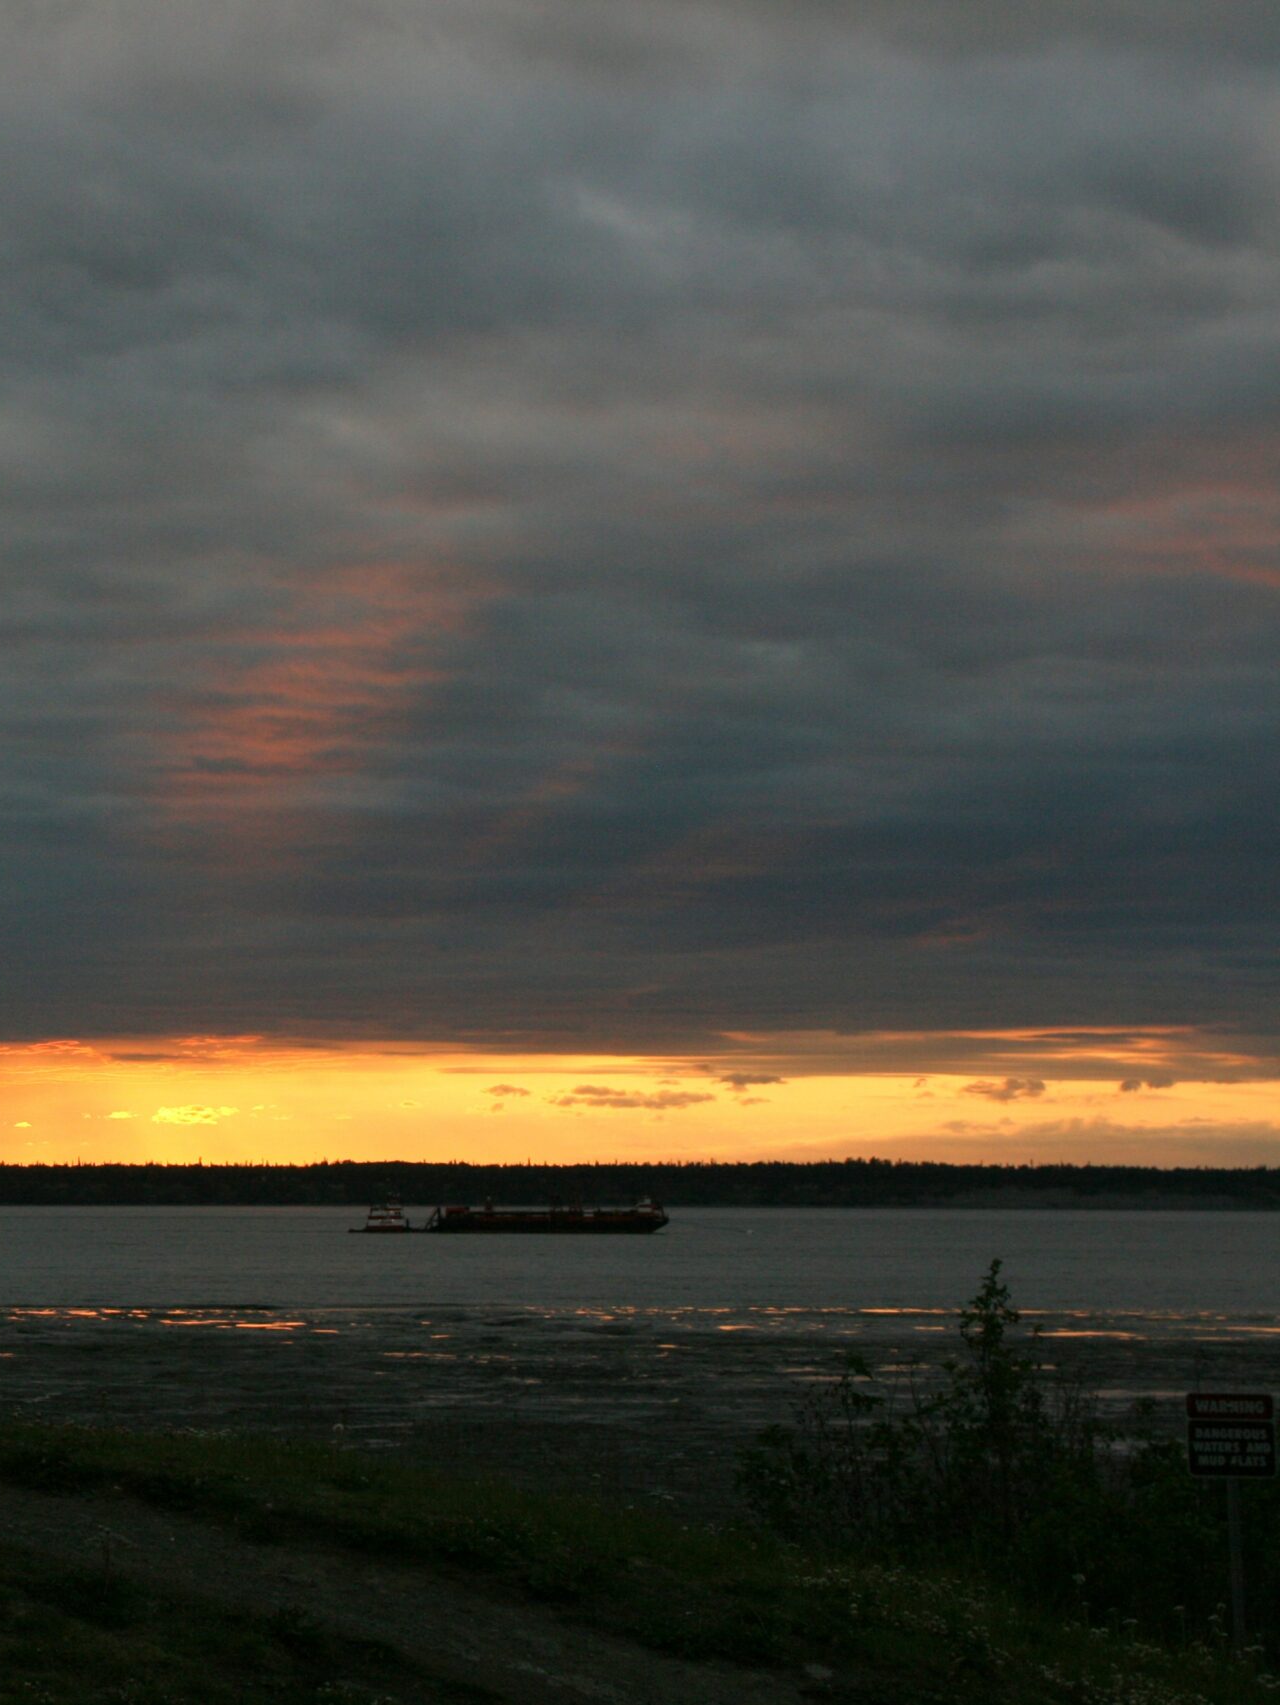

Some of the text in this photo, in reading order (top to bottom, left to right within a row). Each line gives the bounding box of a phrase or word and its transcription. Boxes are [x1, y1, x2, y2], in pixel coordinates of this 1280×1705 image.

[1195, 1399, 1265, 1414] WARNING
[1192, 1441, 1272, 1454] WATERS AND
[1197, 1455, 1267, 1467] MUD FLATS
